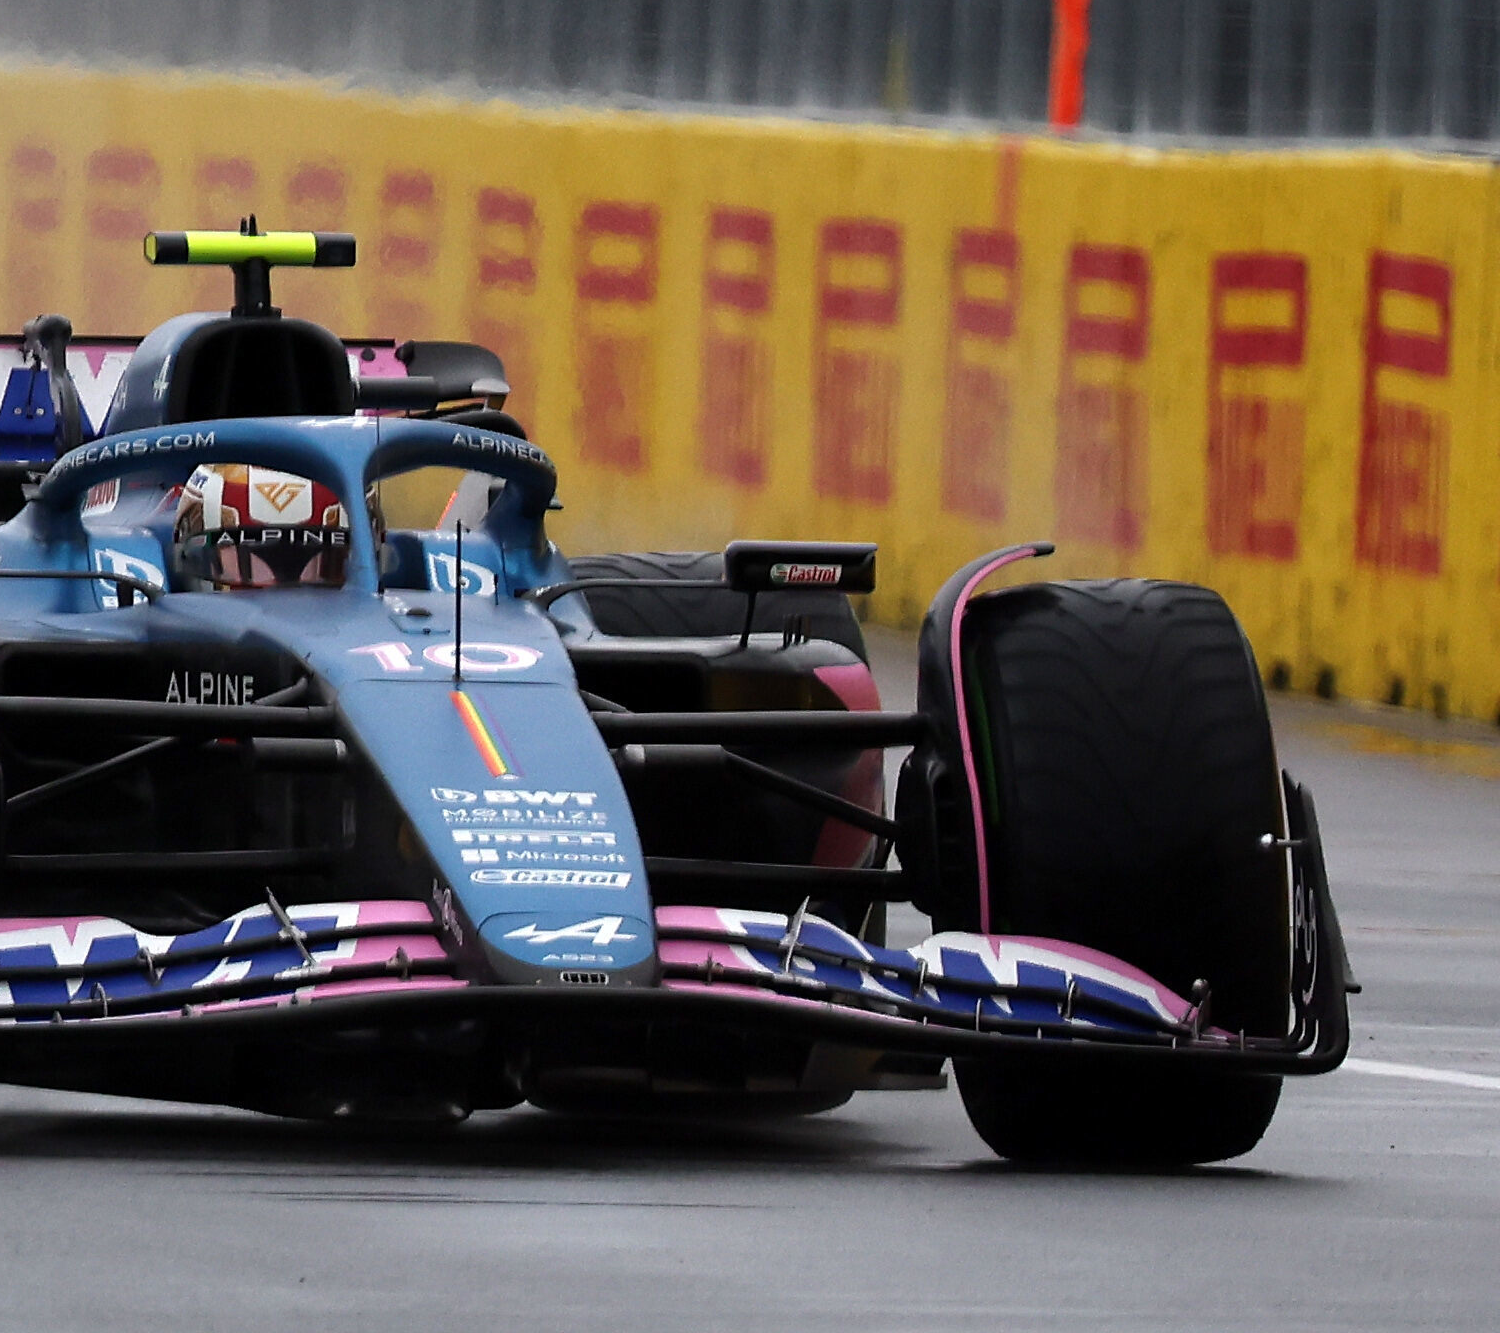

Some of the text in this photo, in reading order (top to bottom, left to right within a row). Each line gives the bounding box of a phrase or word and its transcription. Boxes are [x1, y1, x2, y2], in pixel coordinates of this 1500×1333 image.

[217, 529, 346, 546] ALPINE
[787, 564, 837, 583] Castrol
[349, 641, 544, 672] 10
[165, 670, 254, 707] ALPINE
[482, 789, 597, 807] BWT
[506, 850, 626, 864] Microsoft
[511, 870, 619, 884] Castrol
